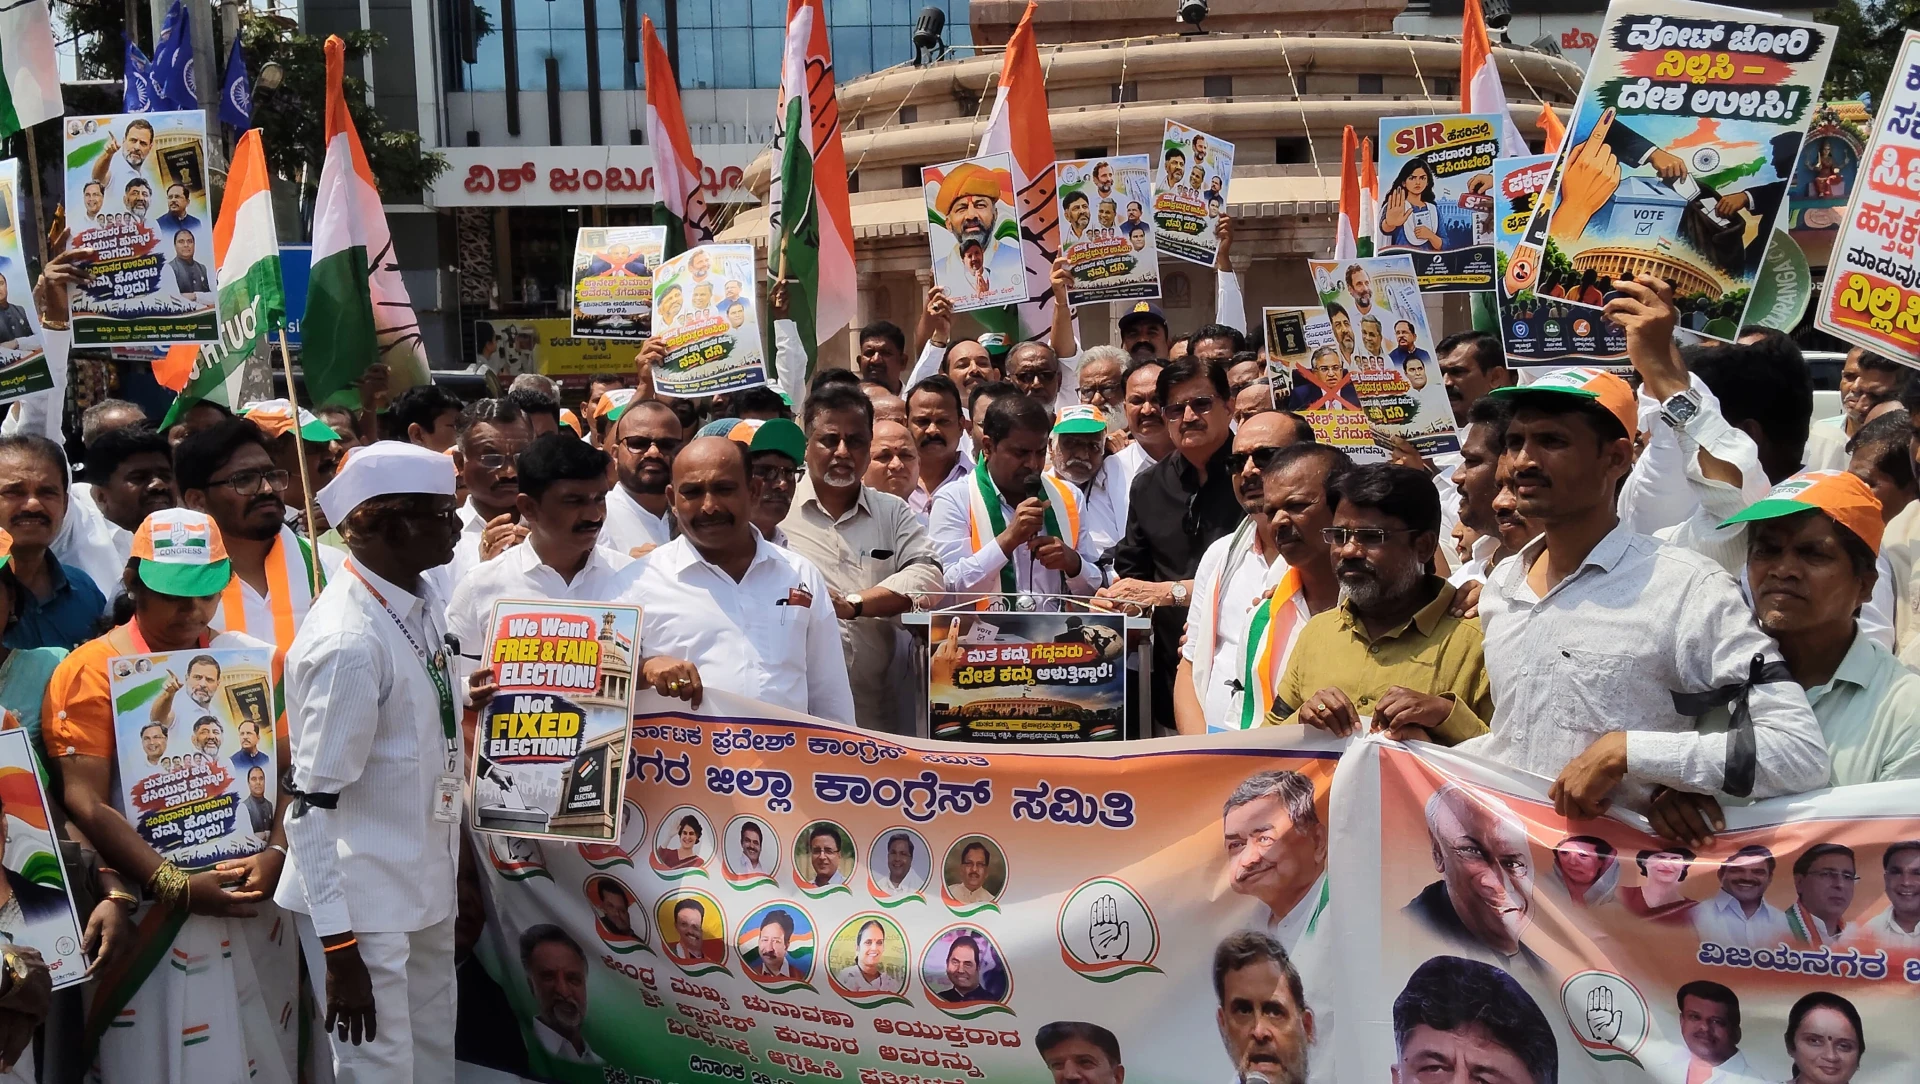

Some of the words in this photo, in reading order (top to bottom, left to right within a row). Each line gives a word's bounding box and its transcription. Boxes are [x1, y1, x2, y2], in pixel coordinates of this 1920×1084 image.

[1627, 17, 1725, 51] ವೋಟ್
[1727, 25, 1810, 56] ಚೋರಿ
[1656, 50, 1735, 84] ನಿಲ್ಲಿಸಿ
[1617, 78, 1687, 110] ದೇಶ
[1690, 89, 1799, 120] ಉಳಿಸಿ!
[1395, 122, 1447, 154] SIR
[1446, 122, 1491, 141] ಹೆಸರಿನಲ್ಲಿ
[1427, 146, 1473, 164] ಮತದಾರರ
[1475, 142, 1496, 157] ಹಕ್ಕು
[1436, 154, 1491, 175] ಕಸಿಯಬೇಡಿ
[1633, 209, 1665, 221] VOTE
[82, 226, 120, 242] ಮತದಾರರ
[121, 223, 138, 236] ಹಕ್ಕು
[119, 233, 151, 248] ಹುನ್ನಾರ
[98, 248, 135, 260] ಸಾಗದು;
[114, 266, 158, 284] ಹೋರಾಟ
[1087, 266, 1109, 278] ನಮ್ಮ
[114, 279, 149, 298] ನಿಲ್ಲದು!
[678, 352, 704, 368] ನಮ್ಮ
[1273, 376, 1285, 387] SIR
[160, 547, 202, 557] CONGRESS
[508, 618, 539, 638] We
[541, 617, 589, 638] Want
[976, 626, 992, 636] VOTE
[493, 638, 541, 663] FREE
[541, 642, 556, 662] &
[556, 639, 599, 666] FAIR
[967, 649, 998, 663] ಮತ
[1001, 646, 1030, 664] ಕದ್ದು
[1031, 644, 1083, 663] ಗೆದ್ದವರು
[498, 663, 596, 688] ELECTION!
[958, 665, 996, 685] ದೇಶ
[1000, 665, 1036, 686] ಕದ್ದು
[1036, 662, 1113, 684] ಆಳುತ್ತಿದ್ದಾರೆ!
[513, 695, 553, 714] Not
[491, 712, 580, 738] FIXED
[489, 738, 578, 757] ELECTION!
[711, 727, 796, 756] ಪ್ರದೇಶ್
[807, 736, 907, 765] ಕಾಂಗ್ರೆಸ್
[921, 753, 991, 767] ಸಮಿತಿ
[141, 783, 188, 804] ಕಸಿಯುವ
[189, 772, 224, 788] ಹುನ್ನಾರ
[144, 770, 189, 790] ಮತದಾರರ
[191, 764, 213, 776] ಹಕ್ಕು
[165, 788, 208, 808] ಸಾಗದು;
[574, 792, 597, 801] ELECTION
[705, 765, 794, 814] ಜಿಲ್ಲಾ
[814, 770, 993, 823] ಕಾಂಗ್ರೆಸ್
[1011, 779, 1137, 830] ಸಮಿತಿ
[145, 807, 193, 828] ಸಂವಿಧಾನದ
[193, 796, 232, 813] ಉಳಿವಿಗಾಗಿ
[151, 822, 183, 840] ನಮ್ಮ
[184, 807, 233, 829] ಹೋರಾಟ
[183, 821, 225, 844] ನಿಲ್ಲದು!
[1697, 941, 1888, 980] ವಿಜಯನಗರ
[600, 955, 658, 991] ಕೇಂದ್ರ
[670, 976, 730, 1011] ಮುಖ್ಯ
[741, 994, 855, 1028] ಚುನಾವಣಾ
[873, 1017, 1022, 1048] ಆಯುಕ್ತರಾದ
[639, 988, 665, 1008] ಶ್ರೀ
[675, 1002, 757, 1033] ಜ್ಞಾನೇಶ್
[773, 1024, 860, 1055] ಕುಮಾರ
[878, 1044, 987, 1078] ಅವರನ್ನು
[666, 1017, 760, 1064] ಬಂಧನಕ್ಕೆ
[767, 1050, 844, 1079] ಆಗ್ರಹಿಸಿ
[689, 1054, 746, 1080] ದಿನಾಂಕ
